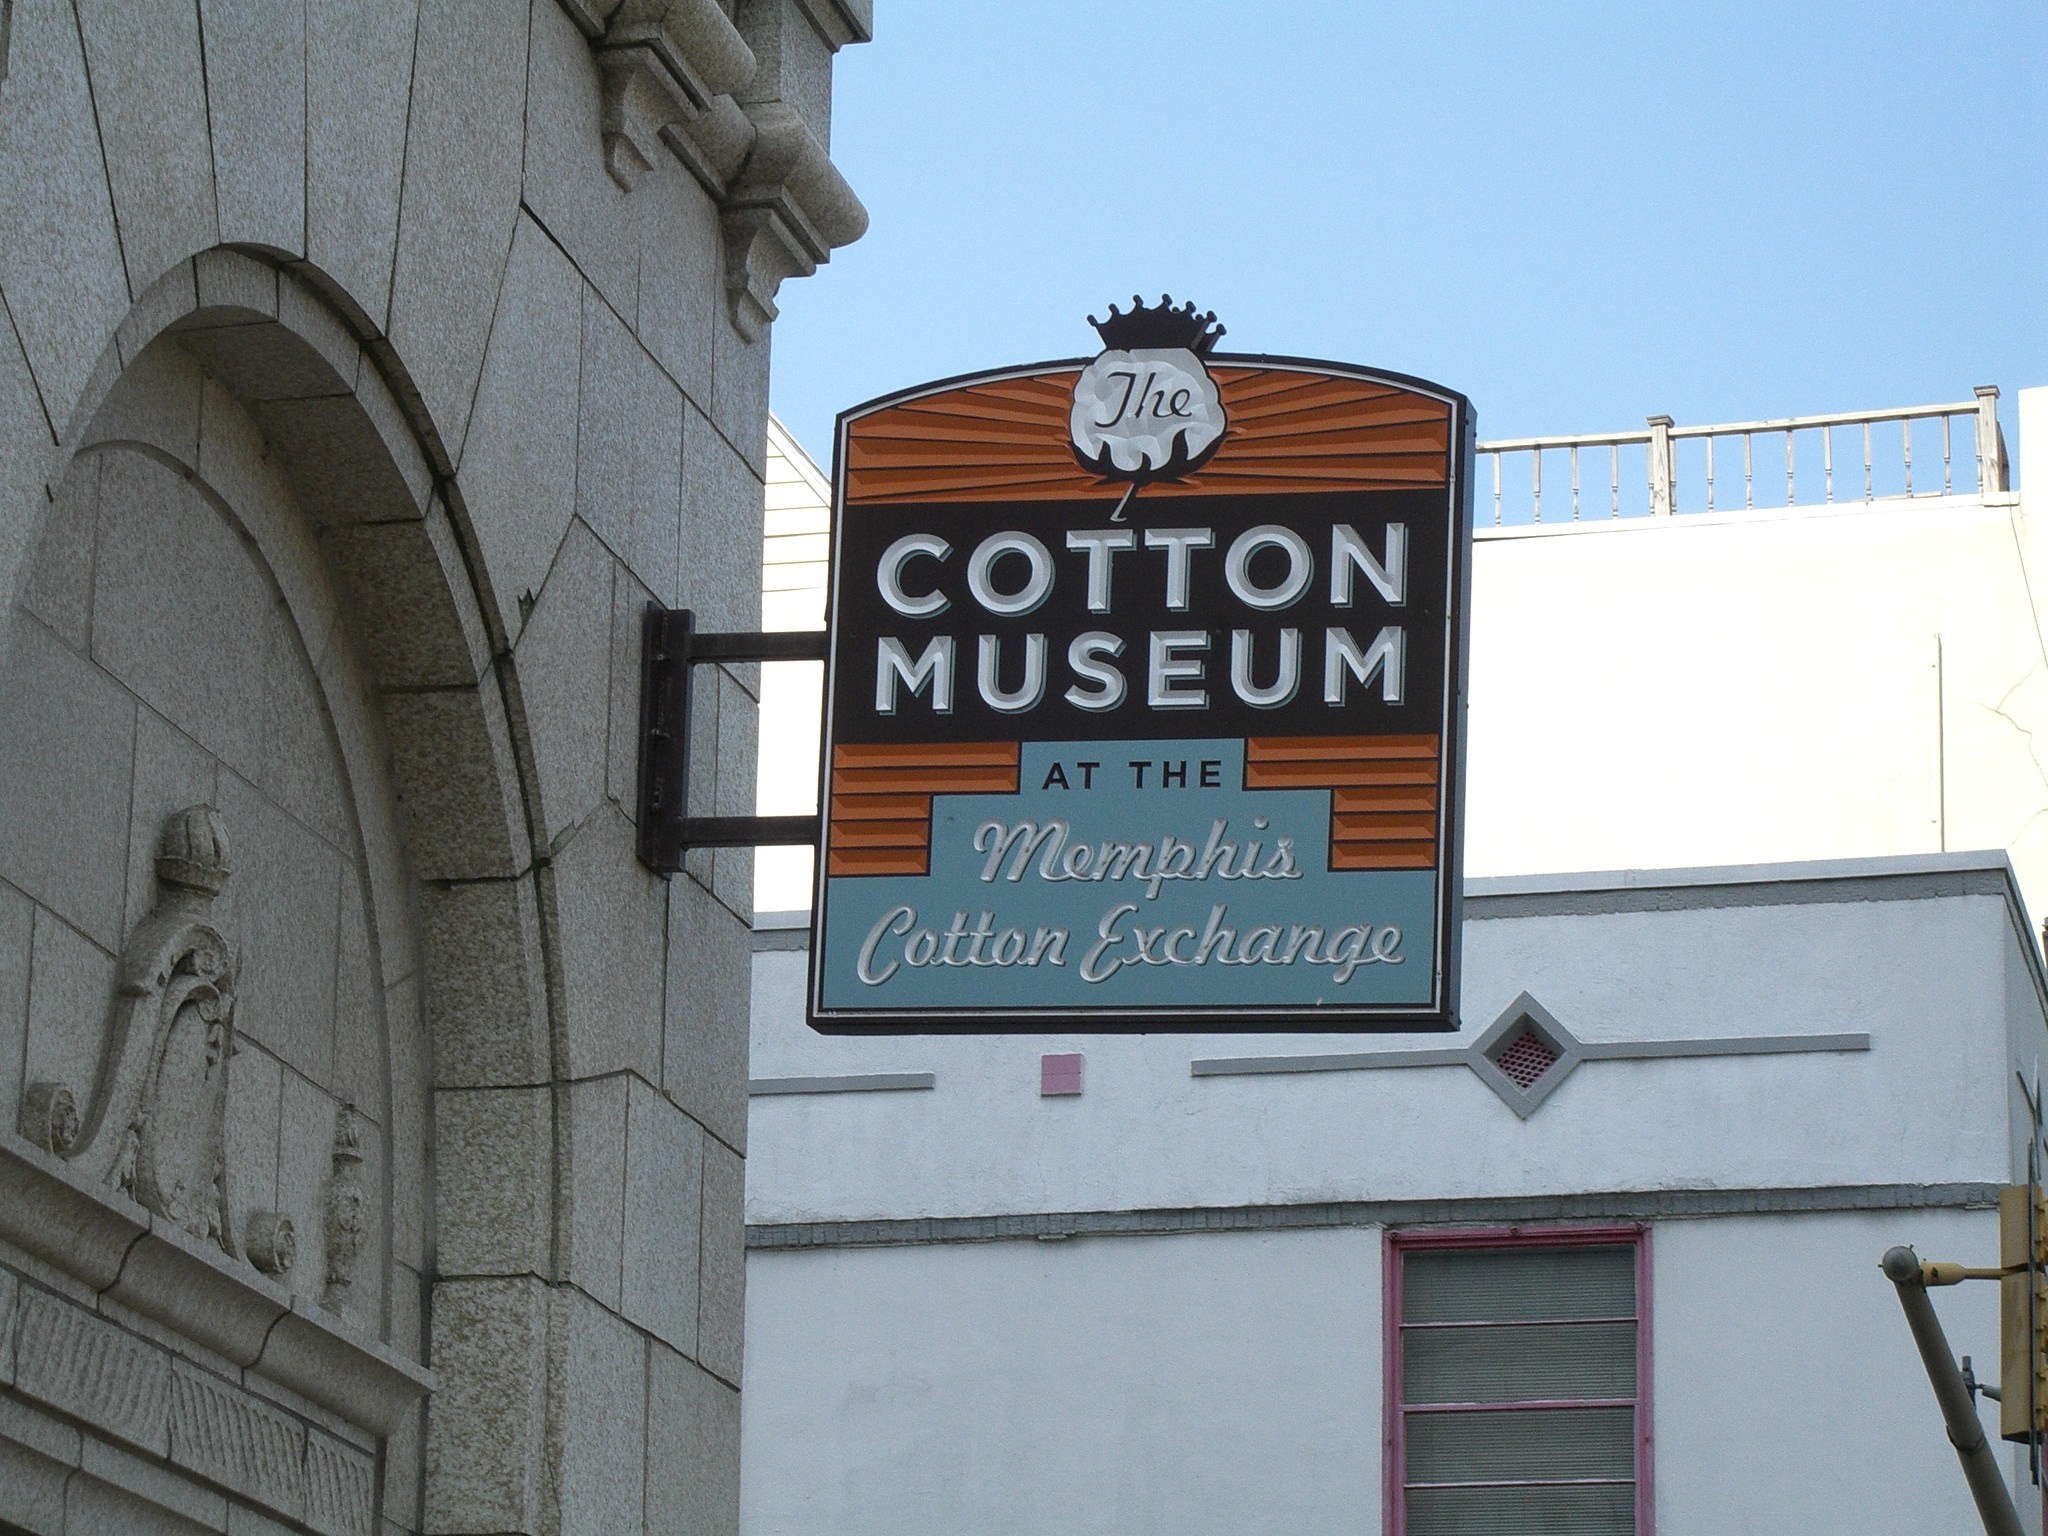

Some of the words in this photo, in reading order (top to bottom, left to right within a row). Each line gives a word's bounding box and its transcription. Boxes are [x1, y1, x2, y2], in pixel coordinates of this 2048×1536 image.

[1095, 371, 1192, 426] The
[876, 522, 1408, 617] COTTON
[875, 625, 1406, 716] MUSEUM
[1041, 760, 1099, 790] AT
[1129, 760, 1222, 789] THE
[973, 815, 1302, 899] Memphis
[857, 904, 1067, 986] Cotton
[1079, 903, 1404, 984] Exchange
